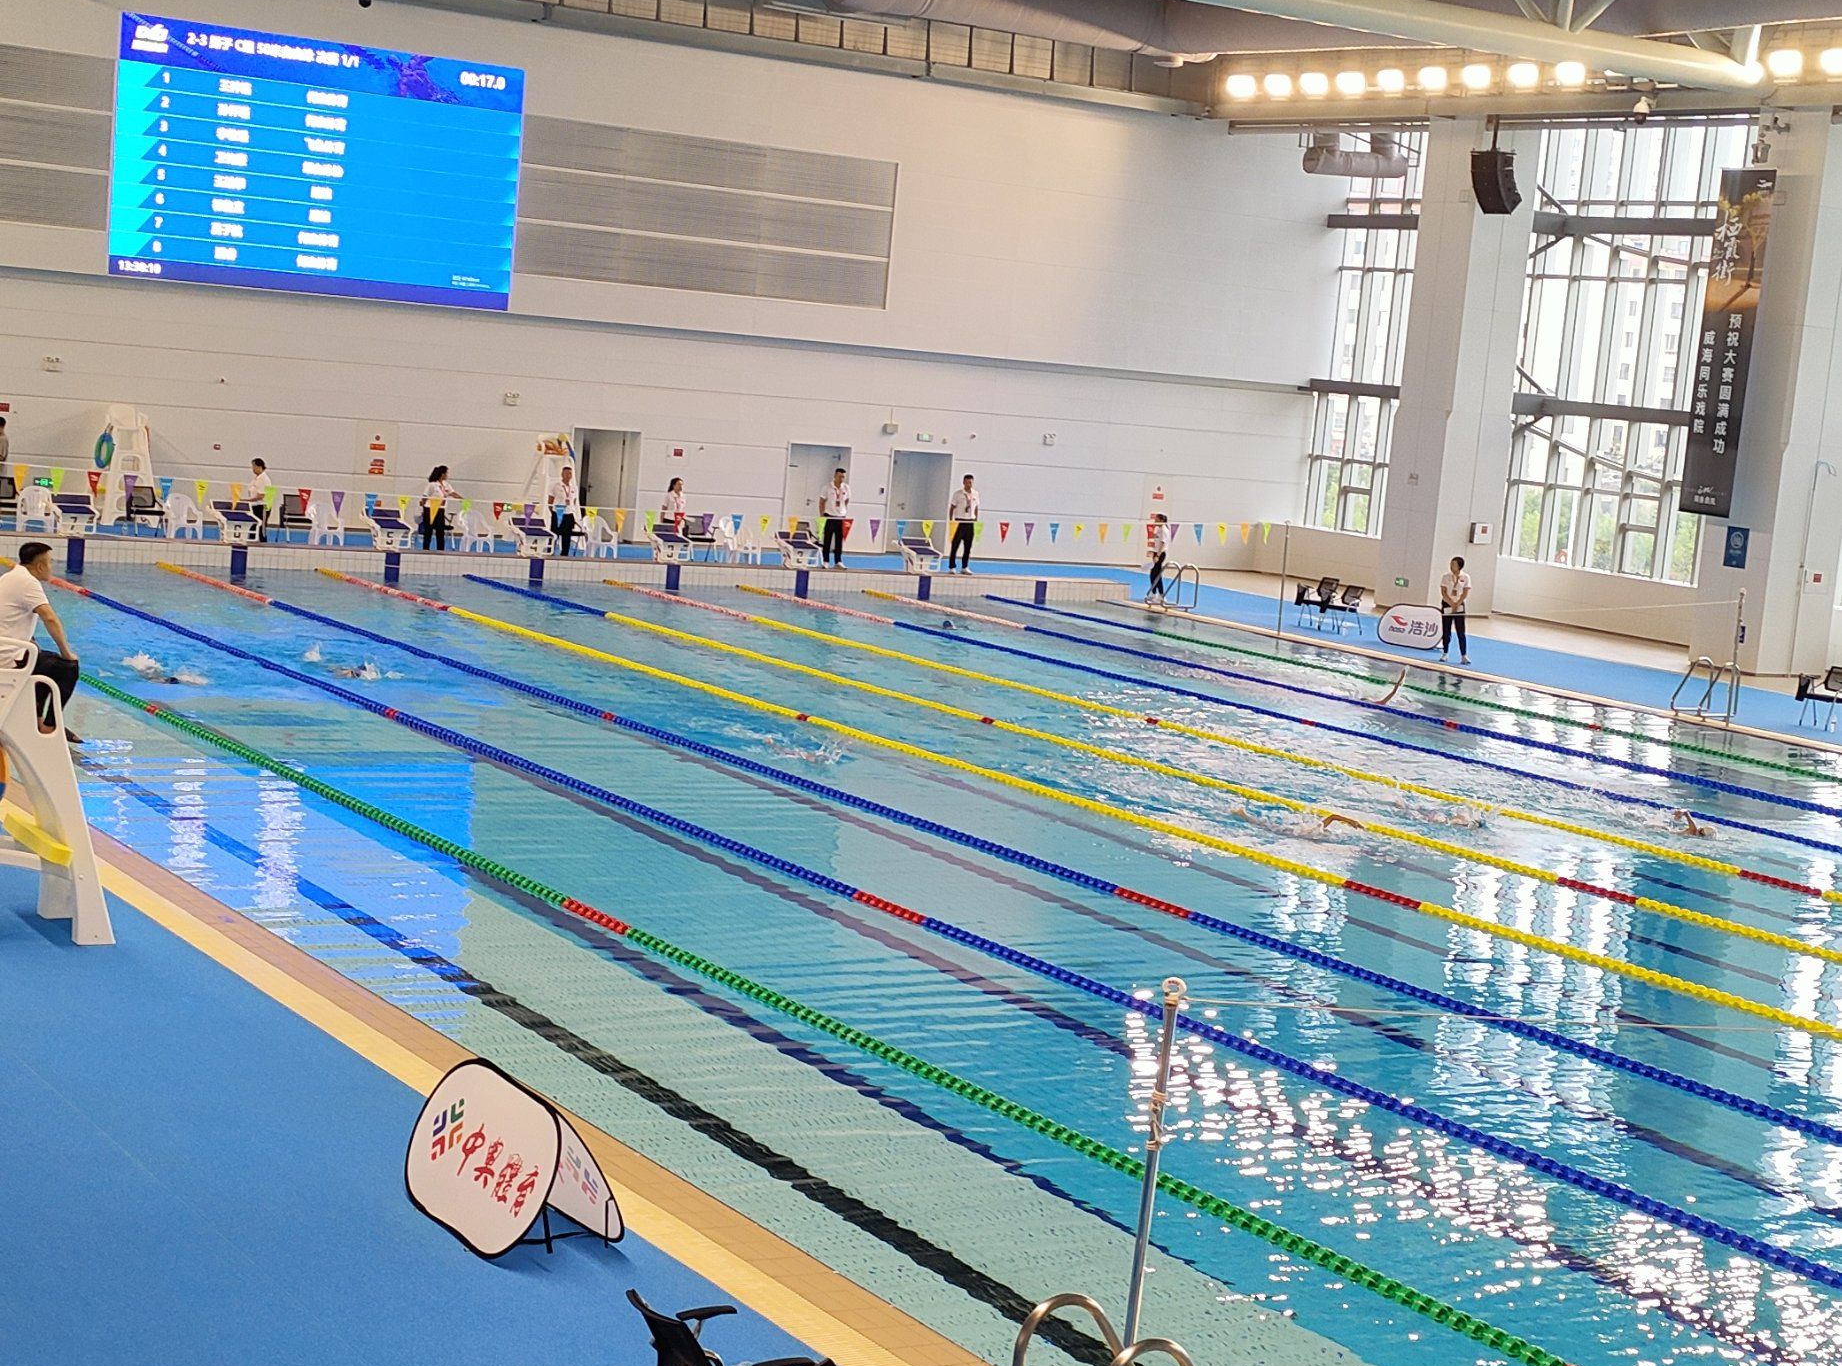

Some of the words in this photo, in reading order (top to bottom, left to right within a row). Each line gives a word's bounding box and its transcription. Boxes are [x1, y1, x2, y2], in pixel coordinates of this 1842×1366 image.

[163, 72, 171, 83] 1
[161, 96, 170, 108] 2
[154, 216, 164, 228] 7
[1693, 330, 1716, 434] 威海同乐戏院
[1712, 313, 1742, 454] 预祝大赛圆满成功
[1408, 619, 1439, 638] 浩沙
